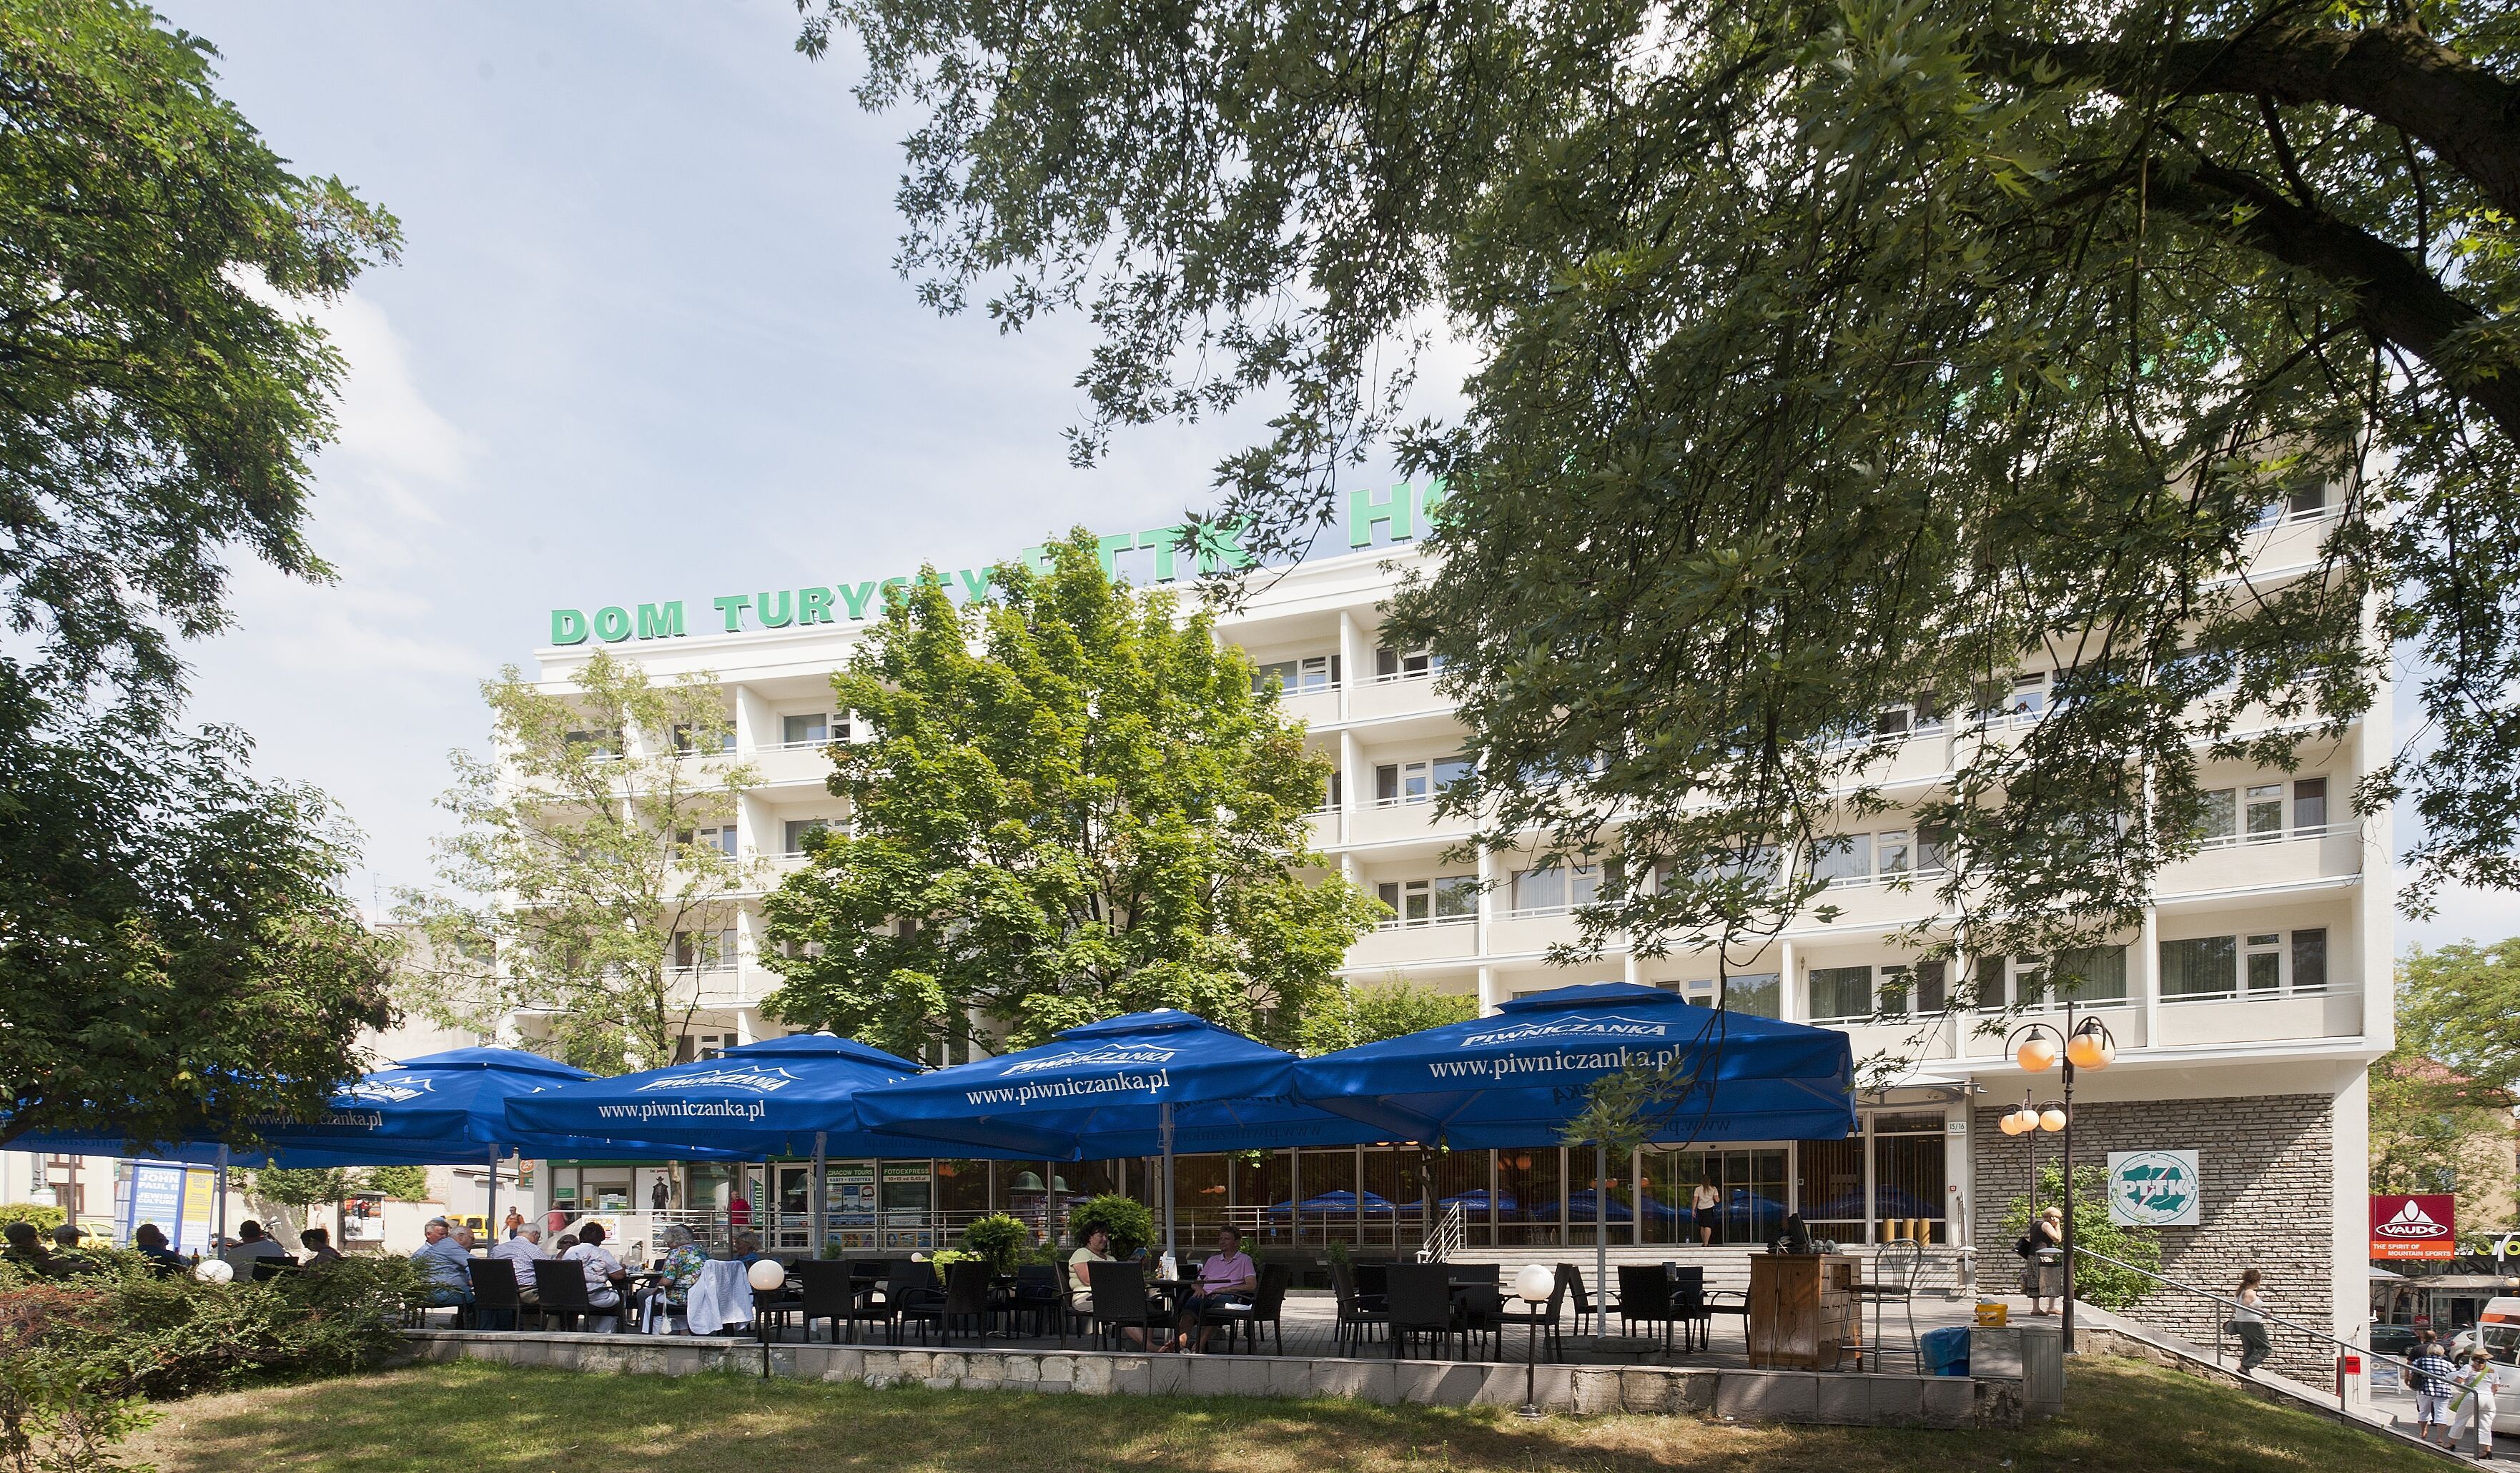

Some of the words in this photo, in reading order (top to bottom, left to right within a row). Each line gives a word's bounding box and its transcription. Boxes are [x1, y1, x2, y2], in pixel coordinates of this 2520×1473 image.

[551, 600, 688, 645] DOM
[1460, 1023, 1666, 1047] PIWNICZANKA
[999, 1051, 1175, 1076] PIWNICZANKA
[1428, 1043, 1682, 1080] www.piwniczanka.pl
[967, 1068, 1170, 1105] www.piwniczanka.pl
[598, 1099, 766, 1121] www.piwniczanka.pl
[137, 1181, 168, 1190] PAUL
[139, 1174, 178, 1183] JOHN
[2120, 1179, 2187, 1197] PTTK
[137, 1191, 177, 1200] JEWISH
[2384, 1226, 2439, 1234] VAUDE
